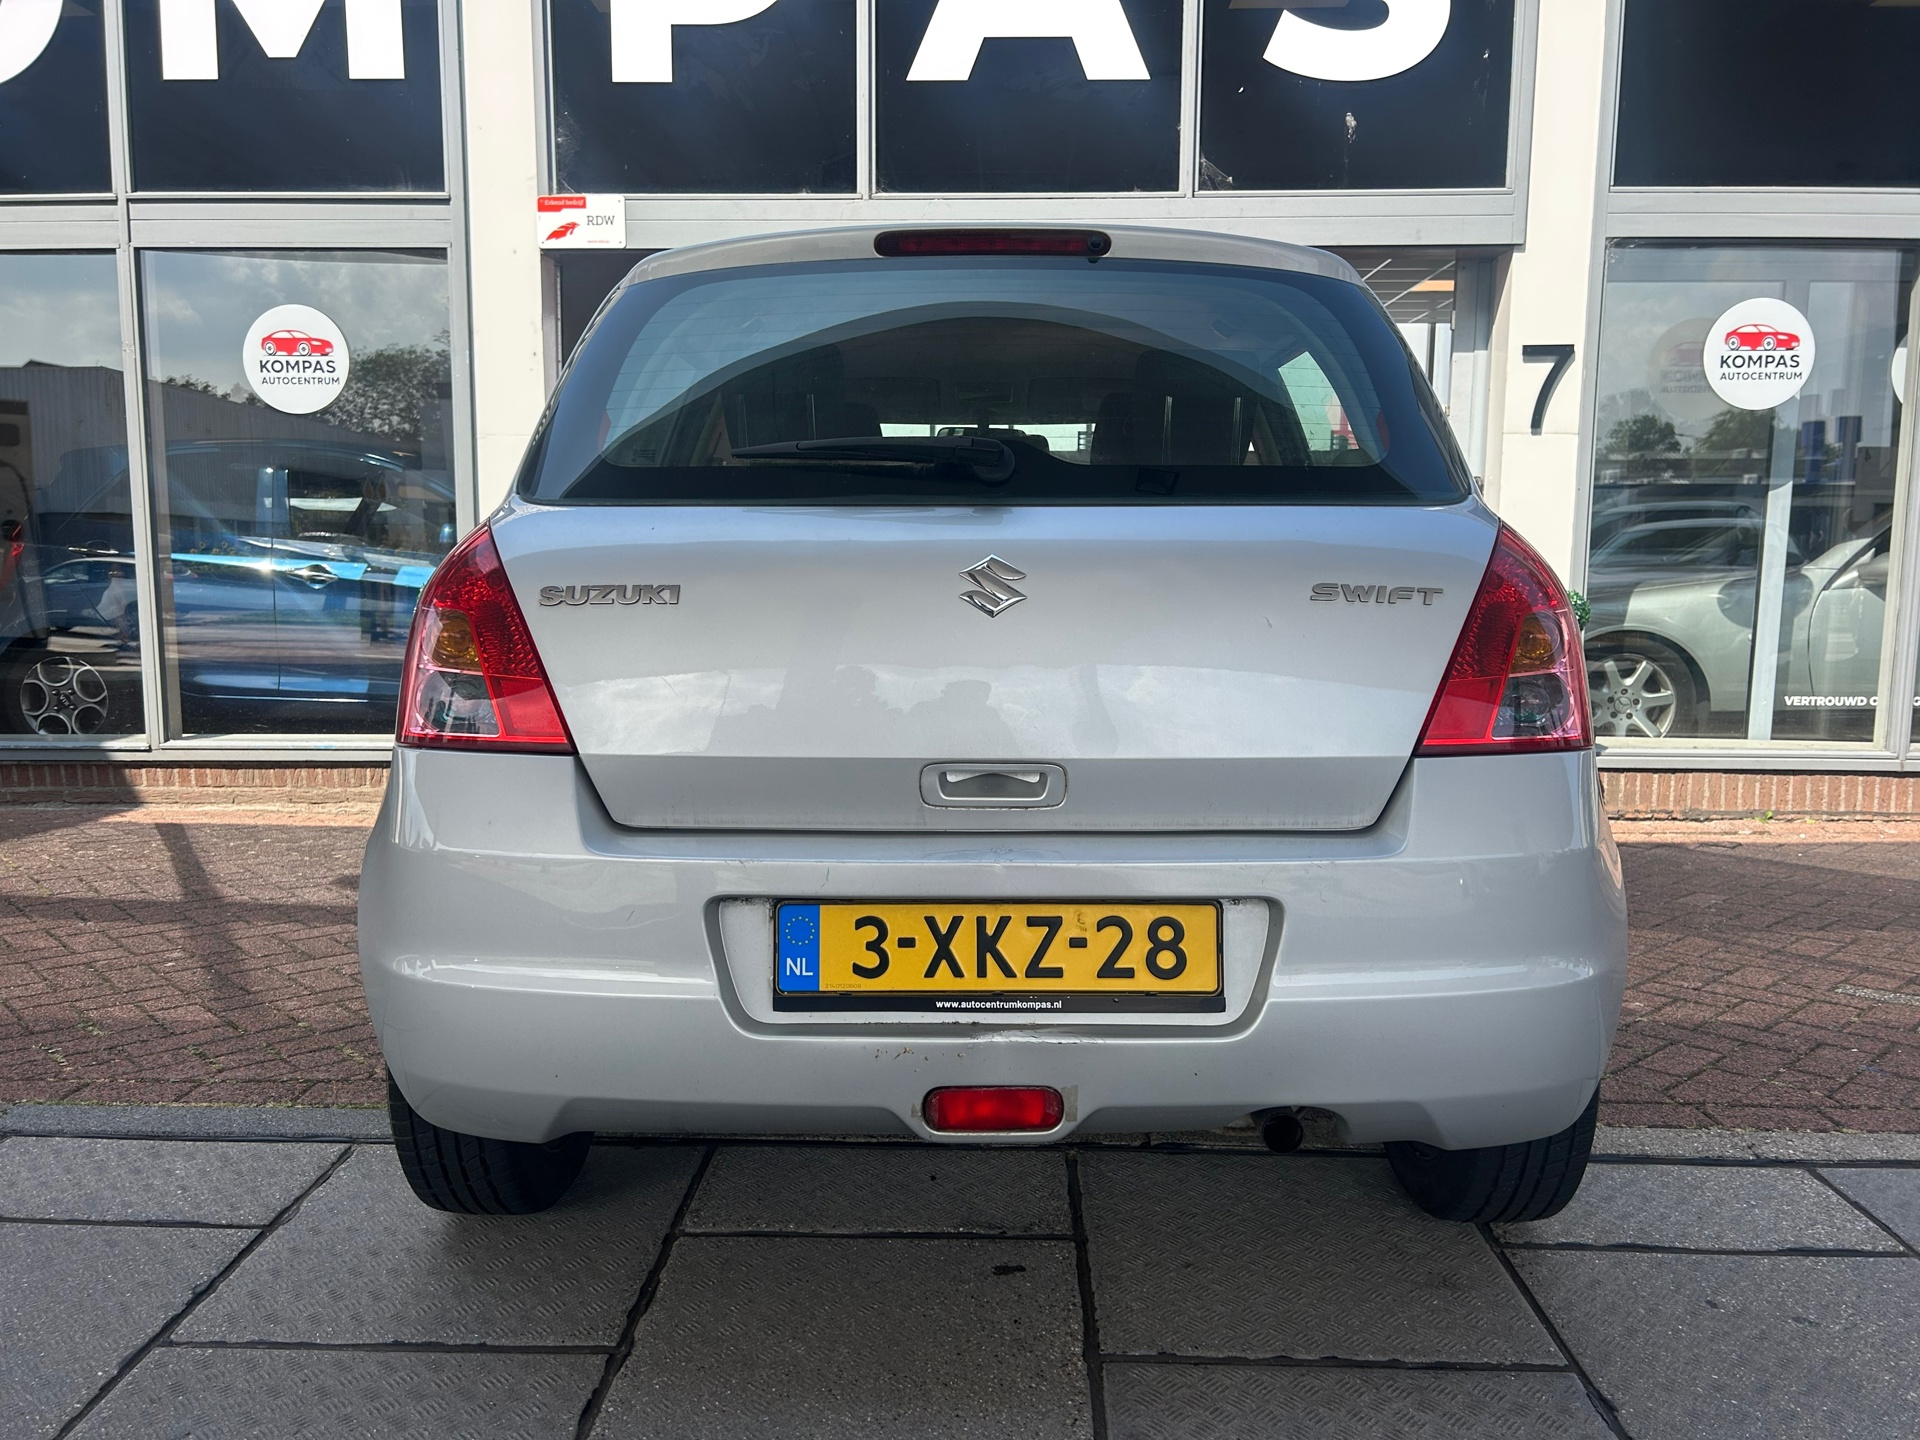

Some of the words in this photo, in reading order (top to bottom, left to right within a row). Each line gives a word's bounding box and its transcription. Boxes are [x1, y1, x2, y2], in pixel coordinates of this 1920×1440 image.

[586, 215, 615, 226] RDW
[259, 360, 336, 373] KOMPAS
[1719, 354, 1801, 369] KOMPAS
[261, 376, 340, 385] AUTOCENTRUM
[1719, 371, 1803, 381] AUTOCENTRUM
[1522, 344, 1575, 431] 7
[539, 584, 681, 607] SUZUKI
[1309, 582, 1444, 606] SWIFT
[1784, 695, 1868, 707] VERTROUWD
[851, 915, 1188, 979] 3-XKZ-28
[786, 957, 814, 976] NL
[935, 1000, 1062, 1010] www.autocentrumkompas.nl
